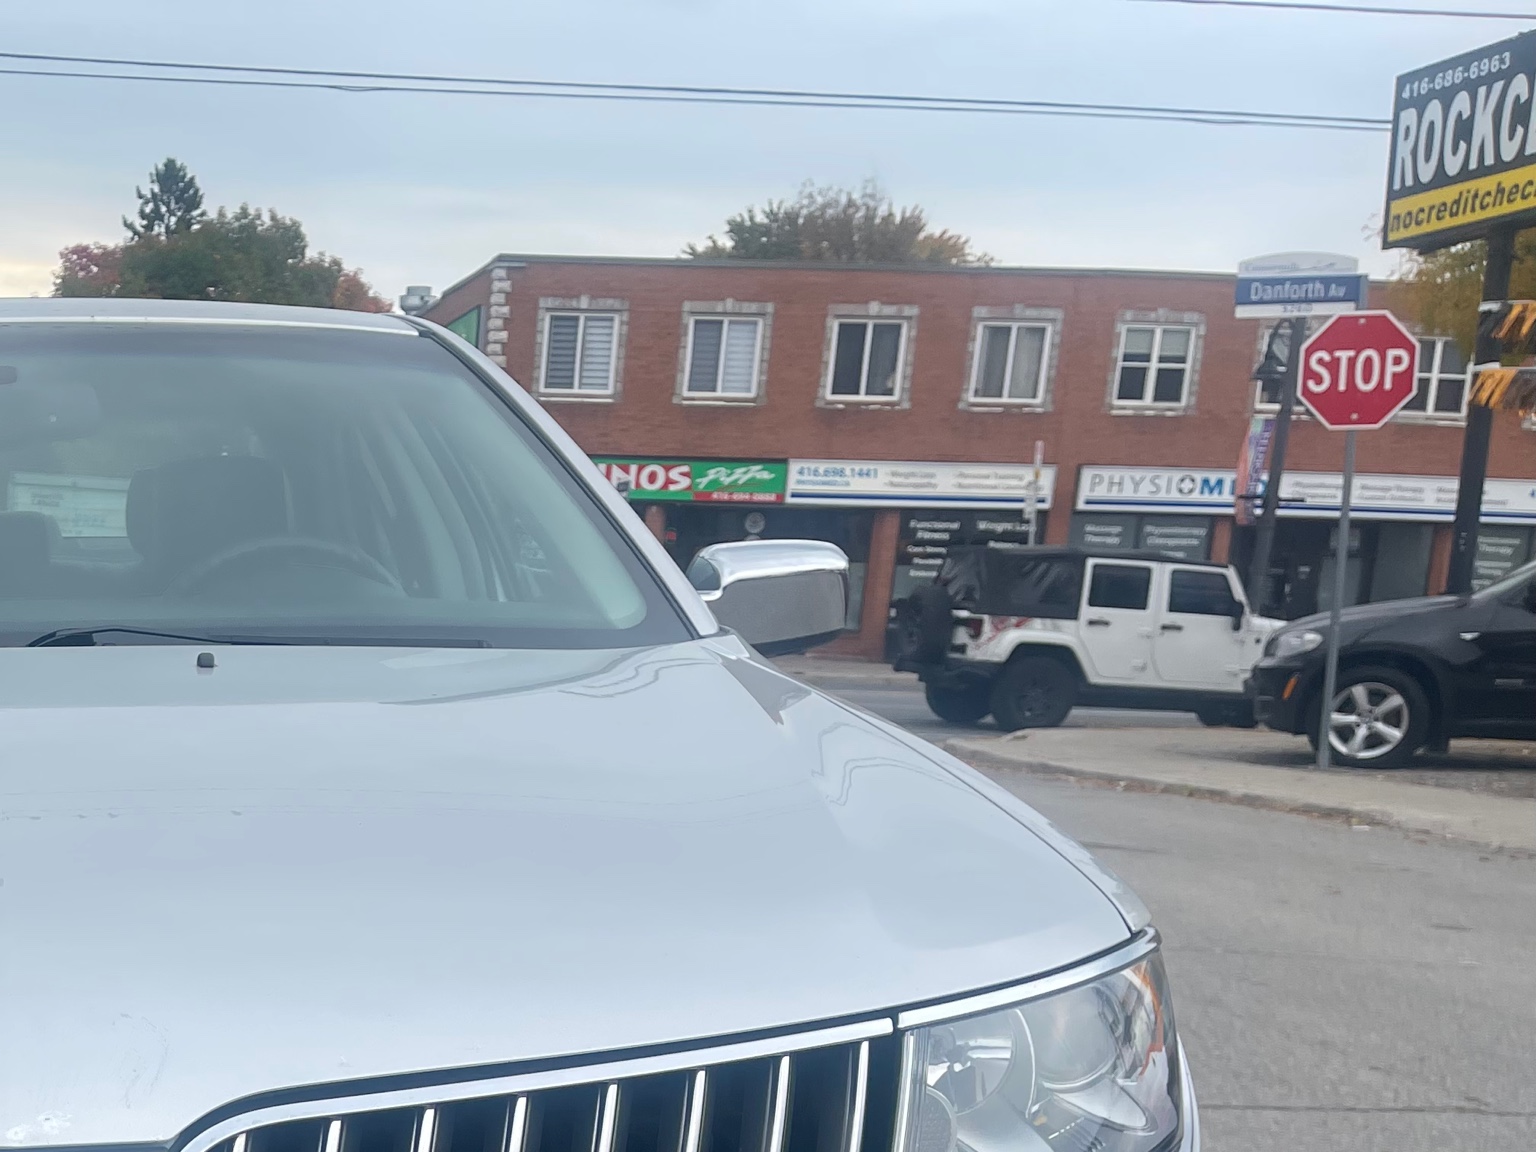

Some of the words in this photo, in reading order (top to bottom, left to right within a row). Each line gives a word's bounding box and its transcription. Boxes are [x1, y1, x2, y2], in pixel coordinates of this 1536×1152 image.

[1401, 51, 1511, 100] 416-686-6963
[1250, 280, 1325, 301] Danforth
[1306, 348, 1410, 393] STOP
